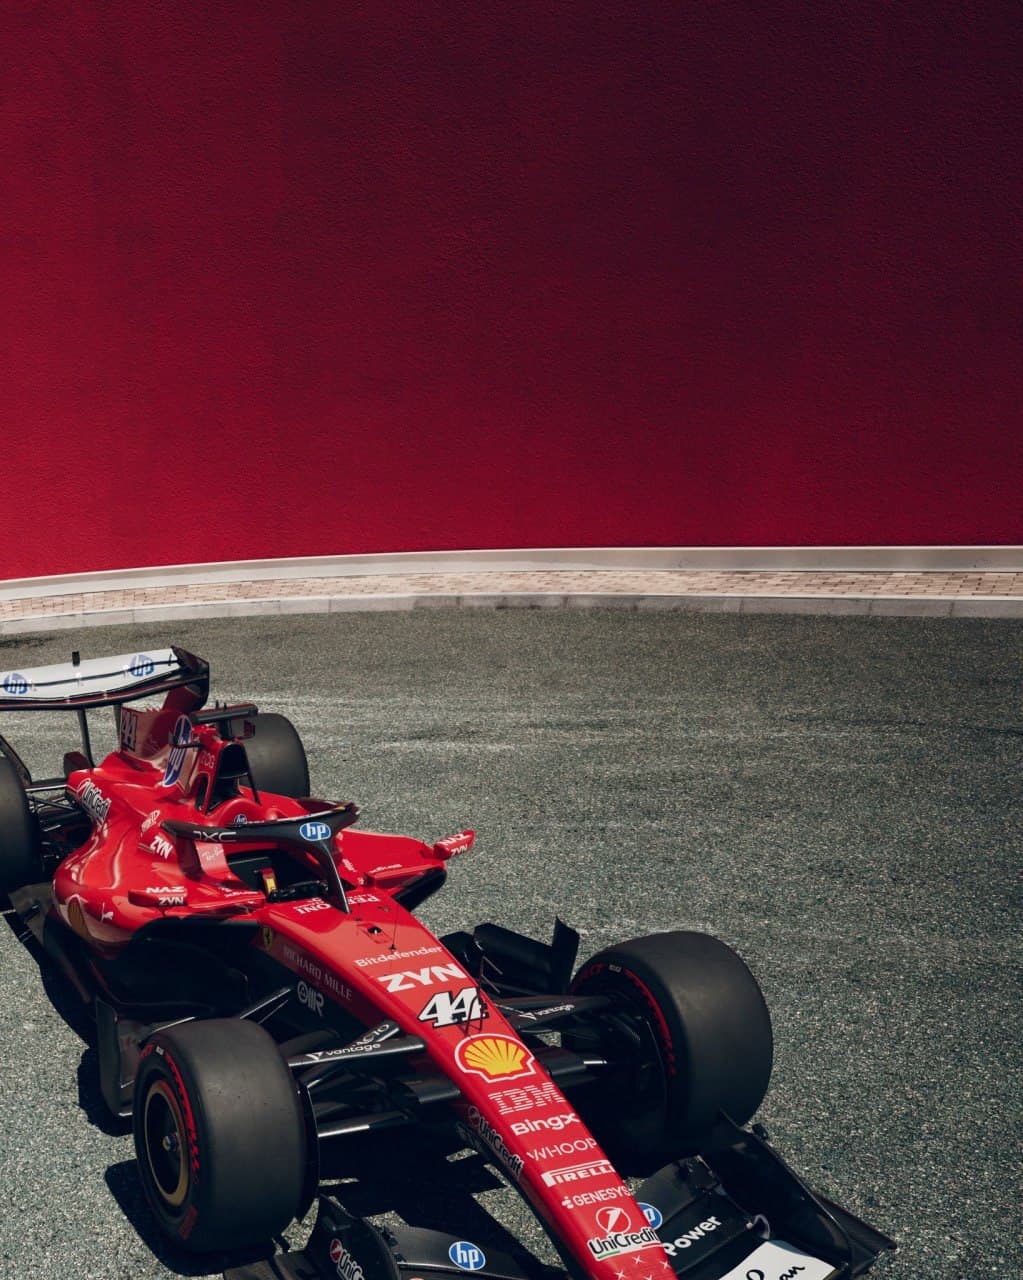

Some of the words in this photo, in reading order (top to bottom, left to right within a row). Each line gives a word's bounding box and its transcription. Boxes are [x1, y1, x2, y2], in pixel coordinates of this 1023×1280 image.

[130, 655, 153, 677] hp
[5, 673, 28, 694] hp
[306, 822, 327, 841] hp
[151, 836, 173, 859] ZYN
[354, 946, 443, 967] Bitdefender
[283, 945, 321, 980] RICHARD
[324, 973, 352, 1000] MILLE
[377, 963, 467, 992] ZYN
[417, 986, 489, 1028] 44
[326, 1043, 381, 1055] vantage
[487, 1081, 566, 1115] IBM
[526, 1137, 597, 1161] WHOOP
[541, 1159, 616, 1187] PIRELLI
[573, 1185, 632, 1206] GENESYS
[588, 1226, 659, 1254] UniCredit
[455, 1241, 481, 1270] hp
